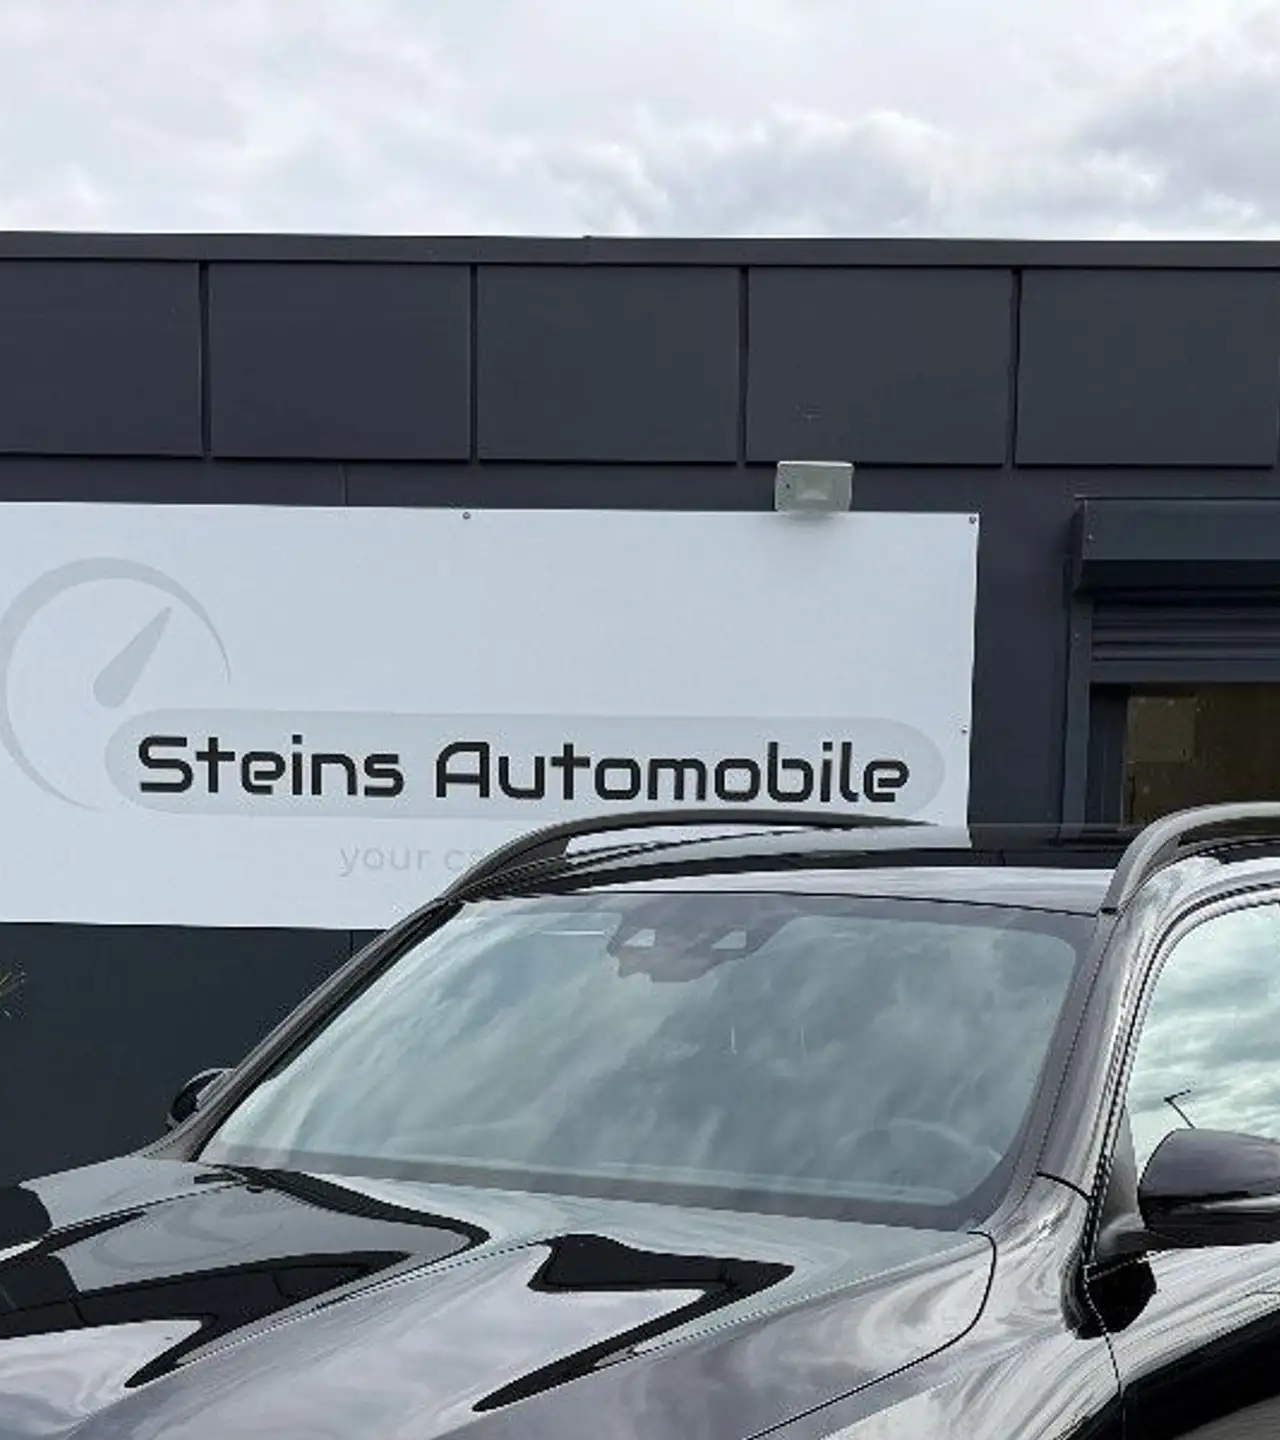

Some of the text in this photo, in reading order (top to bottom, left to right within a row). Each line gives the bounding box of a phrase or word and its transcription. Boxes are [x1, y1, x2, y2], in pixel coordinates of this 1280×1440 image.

[138, 734, 910, 802] Steins Automobile
[339, 847, 431, 877] your
